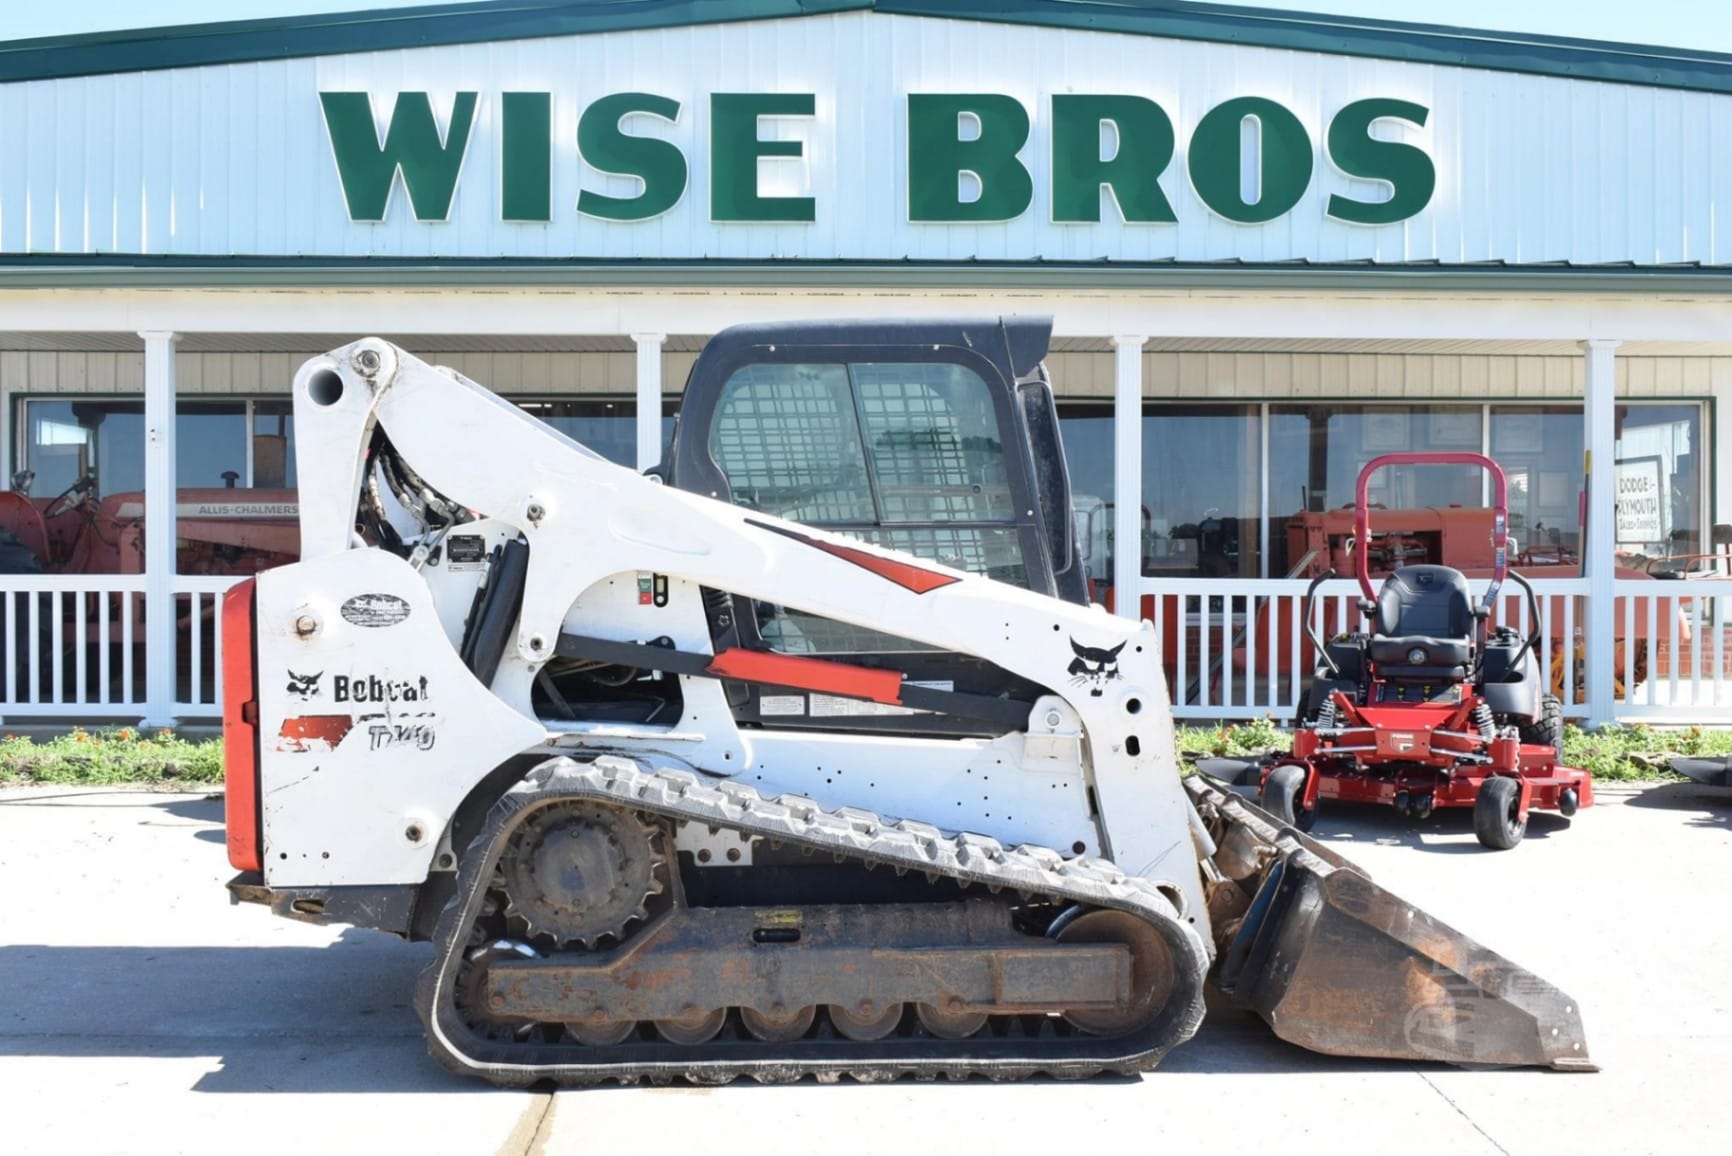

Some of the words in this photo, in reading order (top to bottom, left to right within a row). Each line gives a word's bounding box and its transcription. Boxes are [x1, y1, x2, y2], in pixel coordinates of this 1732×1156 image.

[319, 91, 816, 221] WISE
[907, 92, 1436, 224] BROS
[198, 505, 298, 515] ALLIS-CHALMERS
[333, 674, 429, 702] Bobcat
